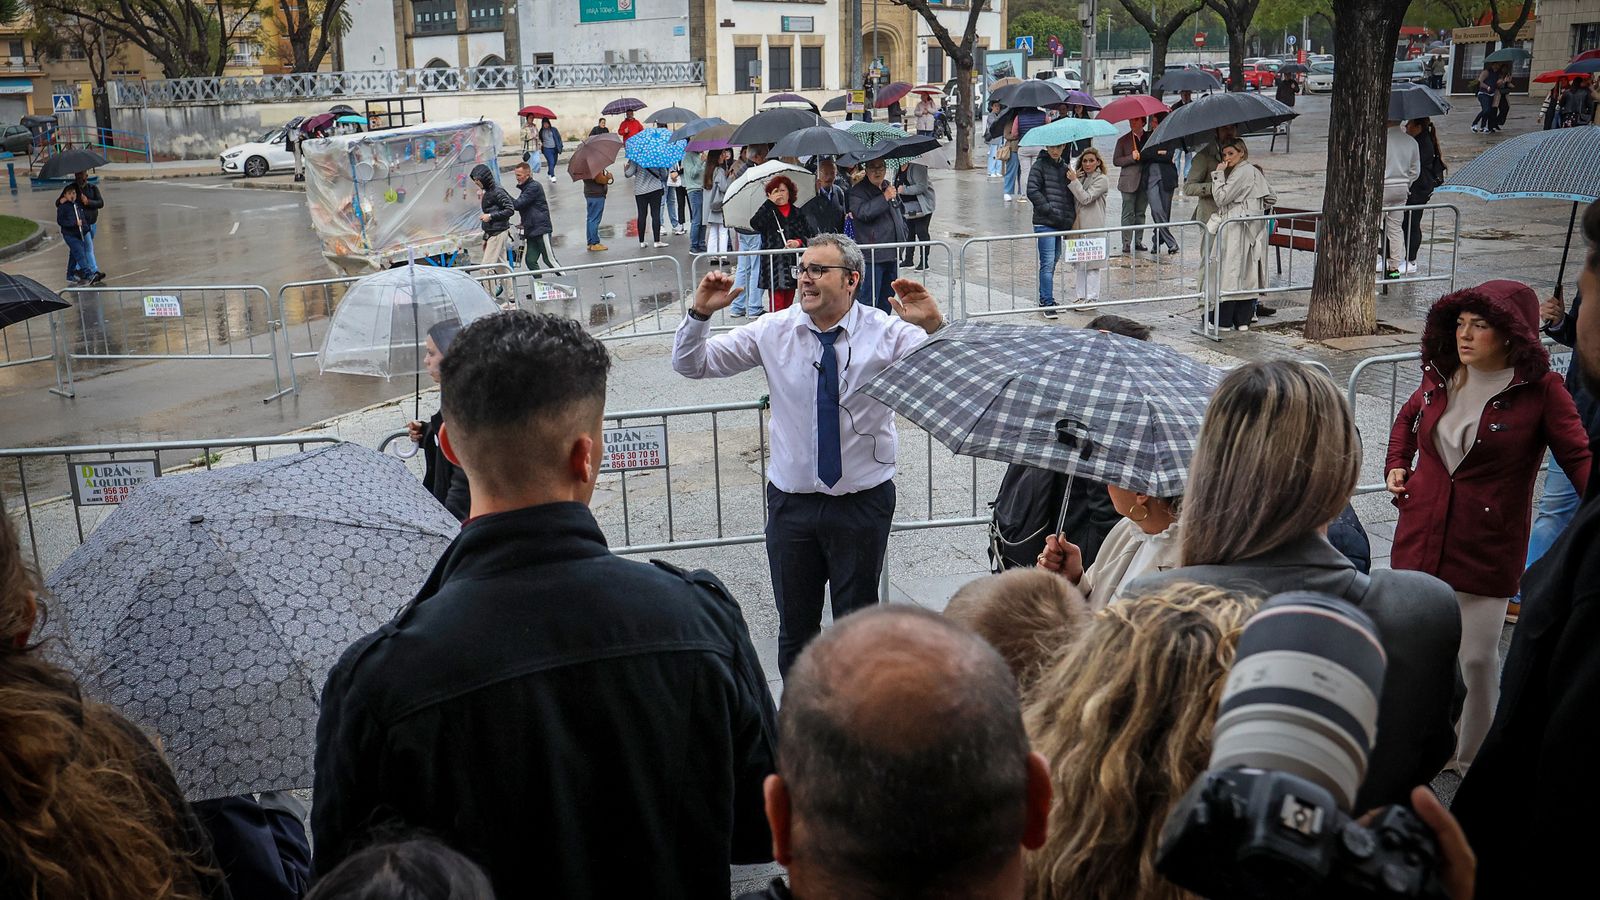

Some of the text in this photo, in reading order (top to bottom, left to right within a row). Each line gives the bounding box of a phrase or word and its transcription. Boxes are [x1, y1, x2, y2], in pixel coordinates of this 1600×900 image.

[603, 429, 641, 444] URÁN
[604, 441, 660, 453] QUILERES
[611, 452, 625, 461] 956
[627, 451, 637, 459] 30
[639, 450, 648, 458] 70
[611, 460, 626, 469] 856
[627, 459, 637, 468] 00
[640, 458, 648, 466] 16
[650, 458, 660, 466] 59
[103, 486, 118, 495] 956
[119, 486, 129, 494] 30
[104, 494, 119, 503] 856
